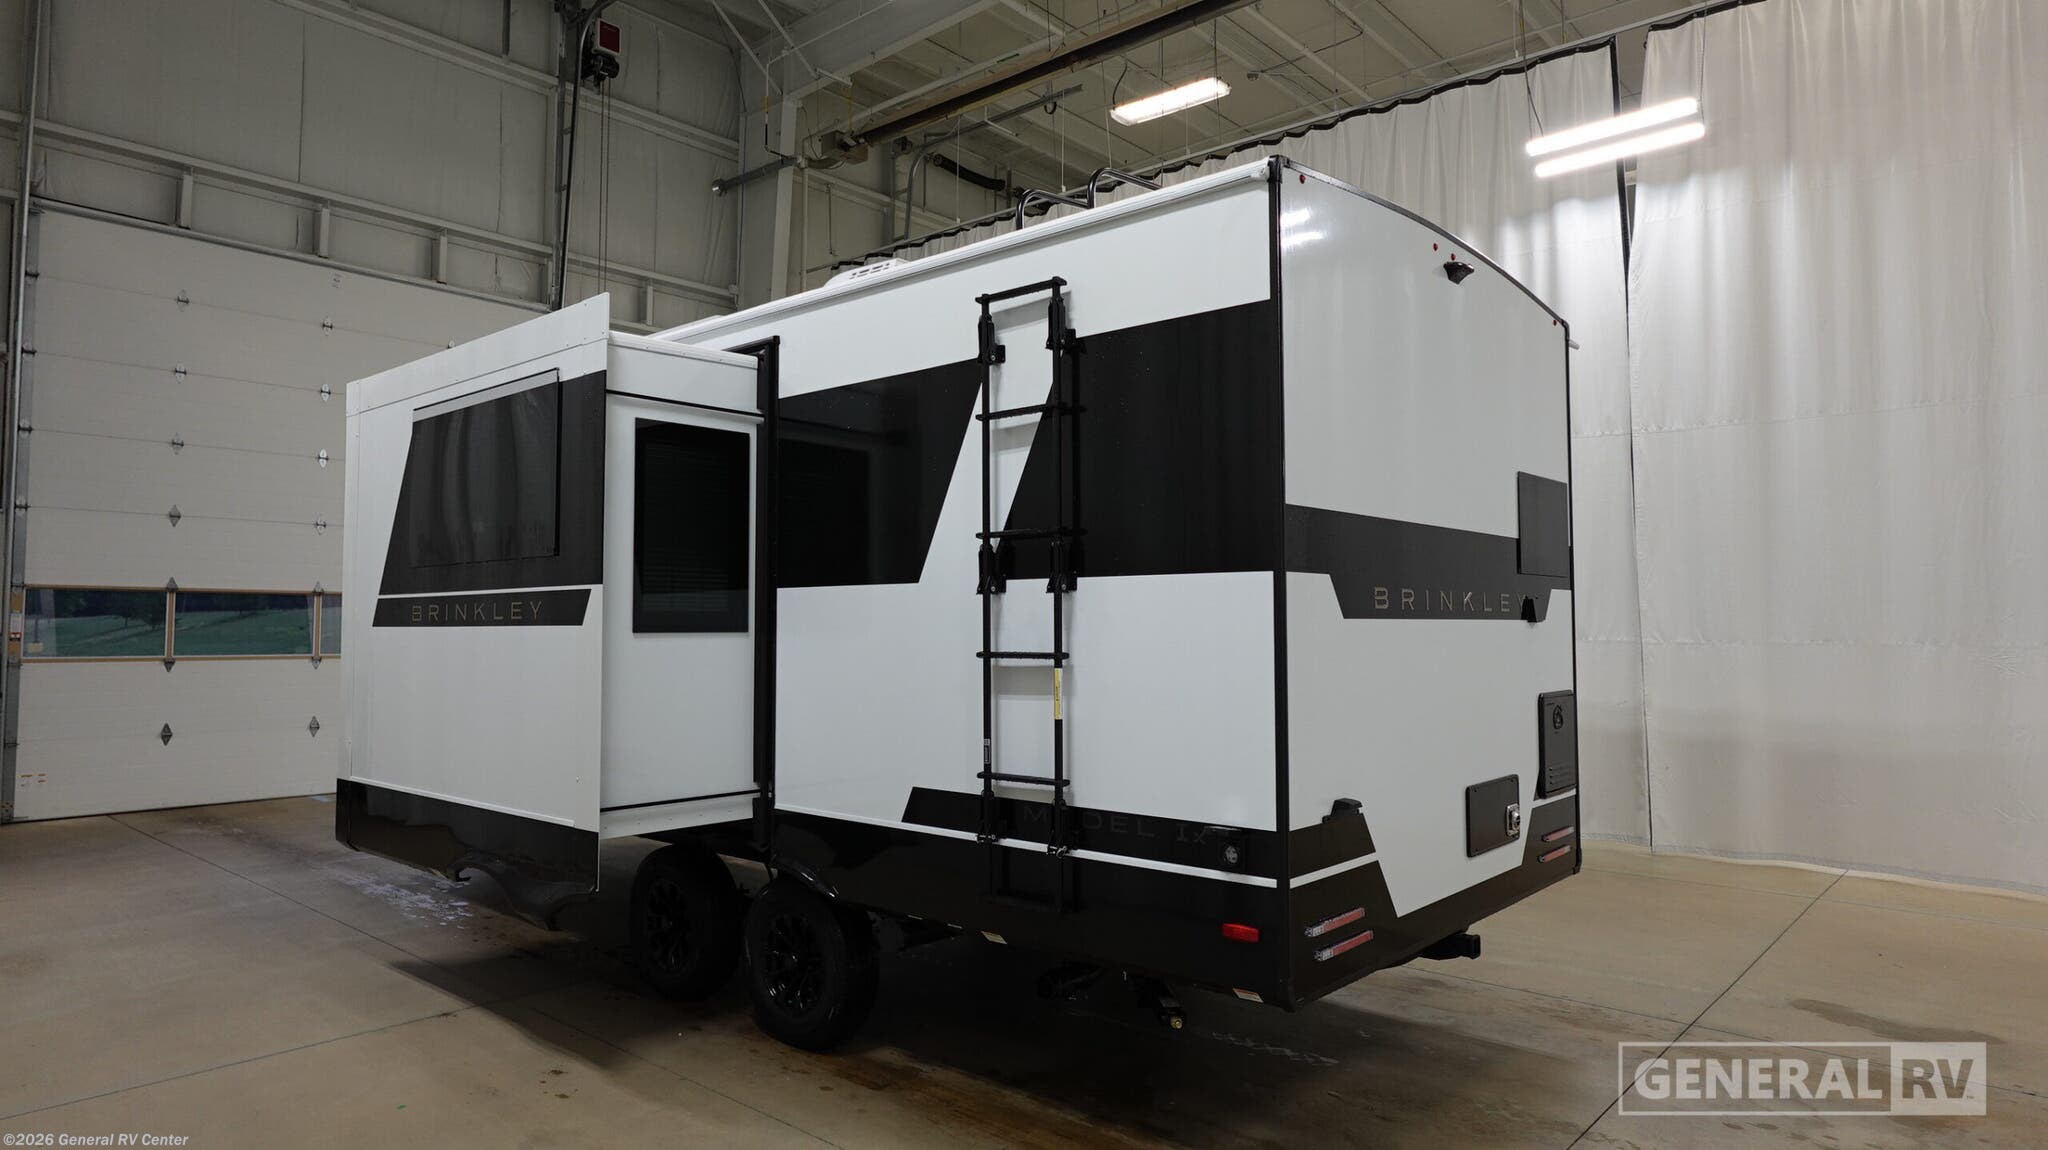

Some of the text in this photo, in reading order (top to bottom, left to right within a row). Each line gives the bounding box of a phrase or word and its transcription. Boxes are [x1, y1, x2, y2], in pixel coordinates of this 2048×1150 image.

[410, 600, 544, 623] BRINKLEY
[1374, 586, 1526, 613] BRINKLEY
[1023, 805, 1156, 838] MDEL
